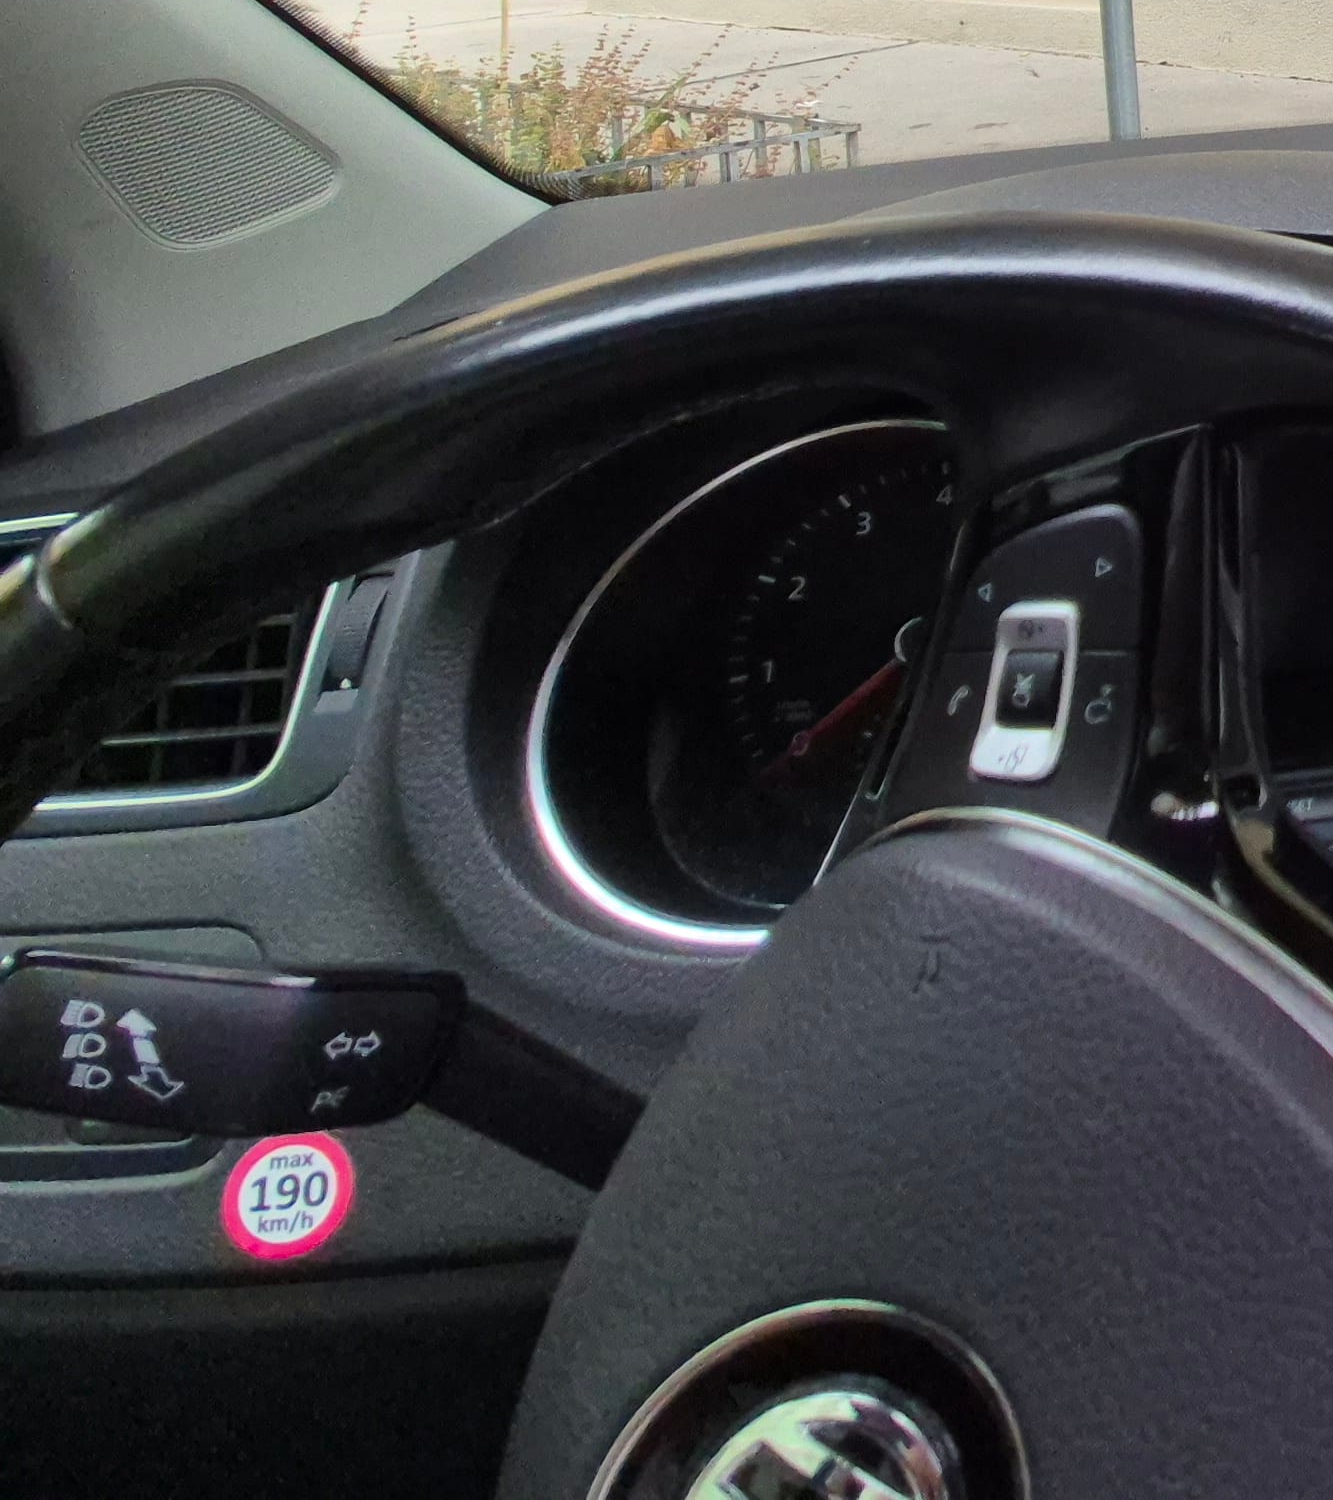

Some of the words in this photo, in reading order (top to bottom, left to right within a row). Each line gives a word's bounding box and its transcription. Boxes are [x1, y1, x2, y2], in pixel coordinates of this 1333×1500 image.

[855, 511, 873, 536] 3
[786, 576, 807, 603] 2
[762, 660, 775, 684] 1
[269, 1152, 314, 1170] max
[249, 1170, 329, 1212] 190
[257, 1211, 314, 1233] km/h
